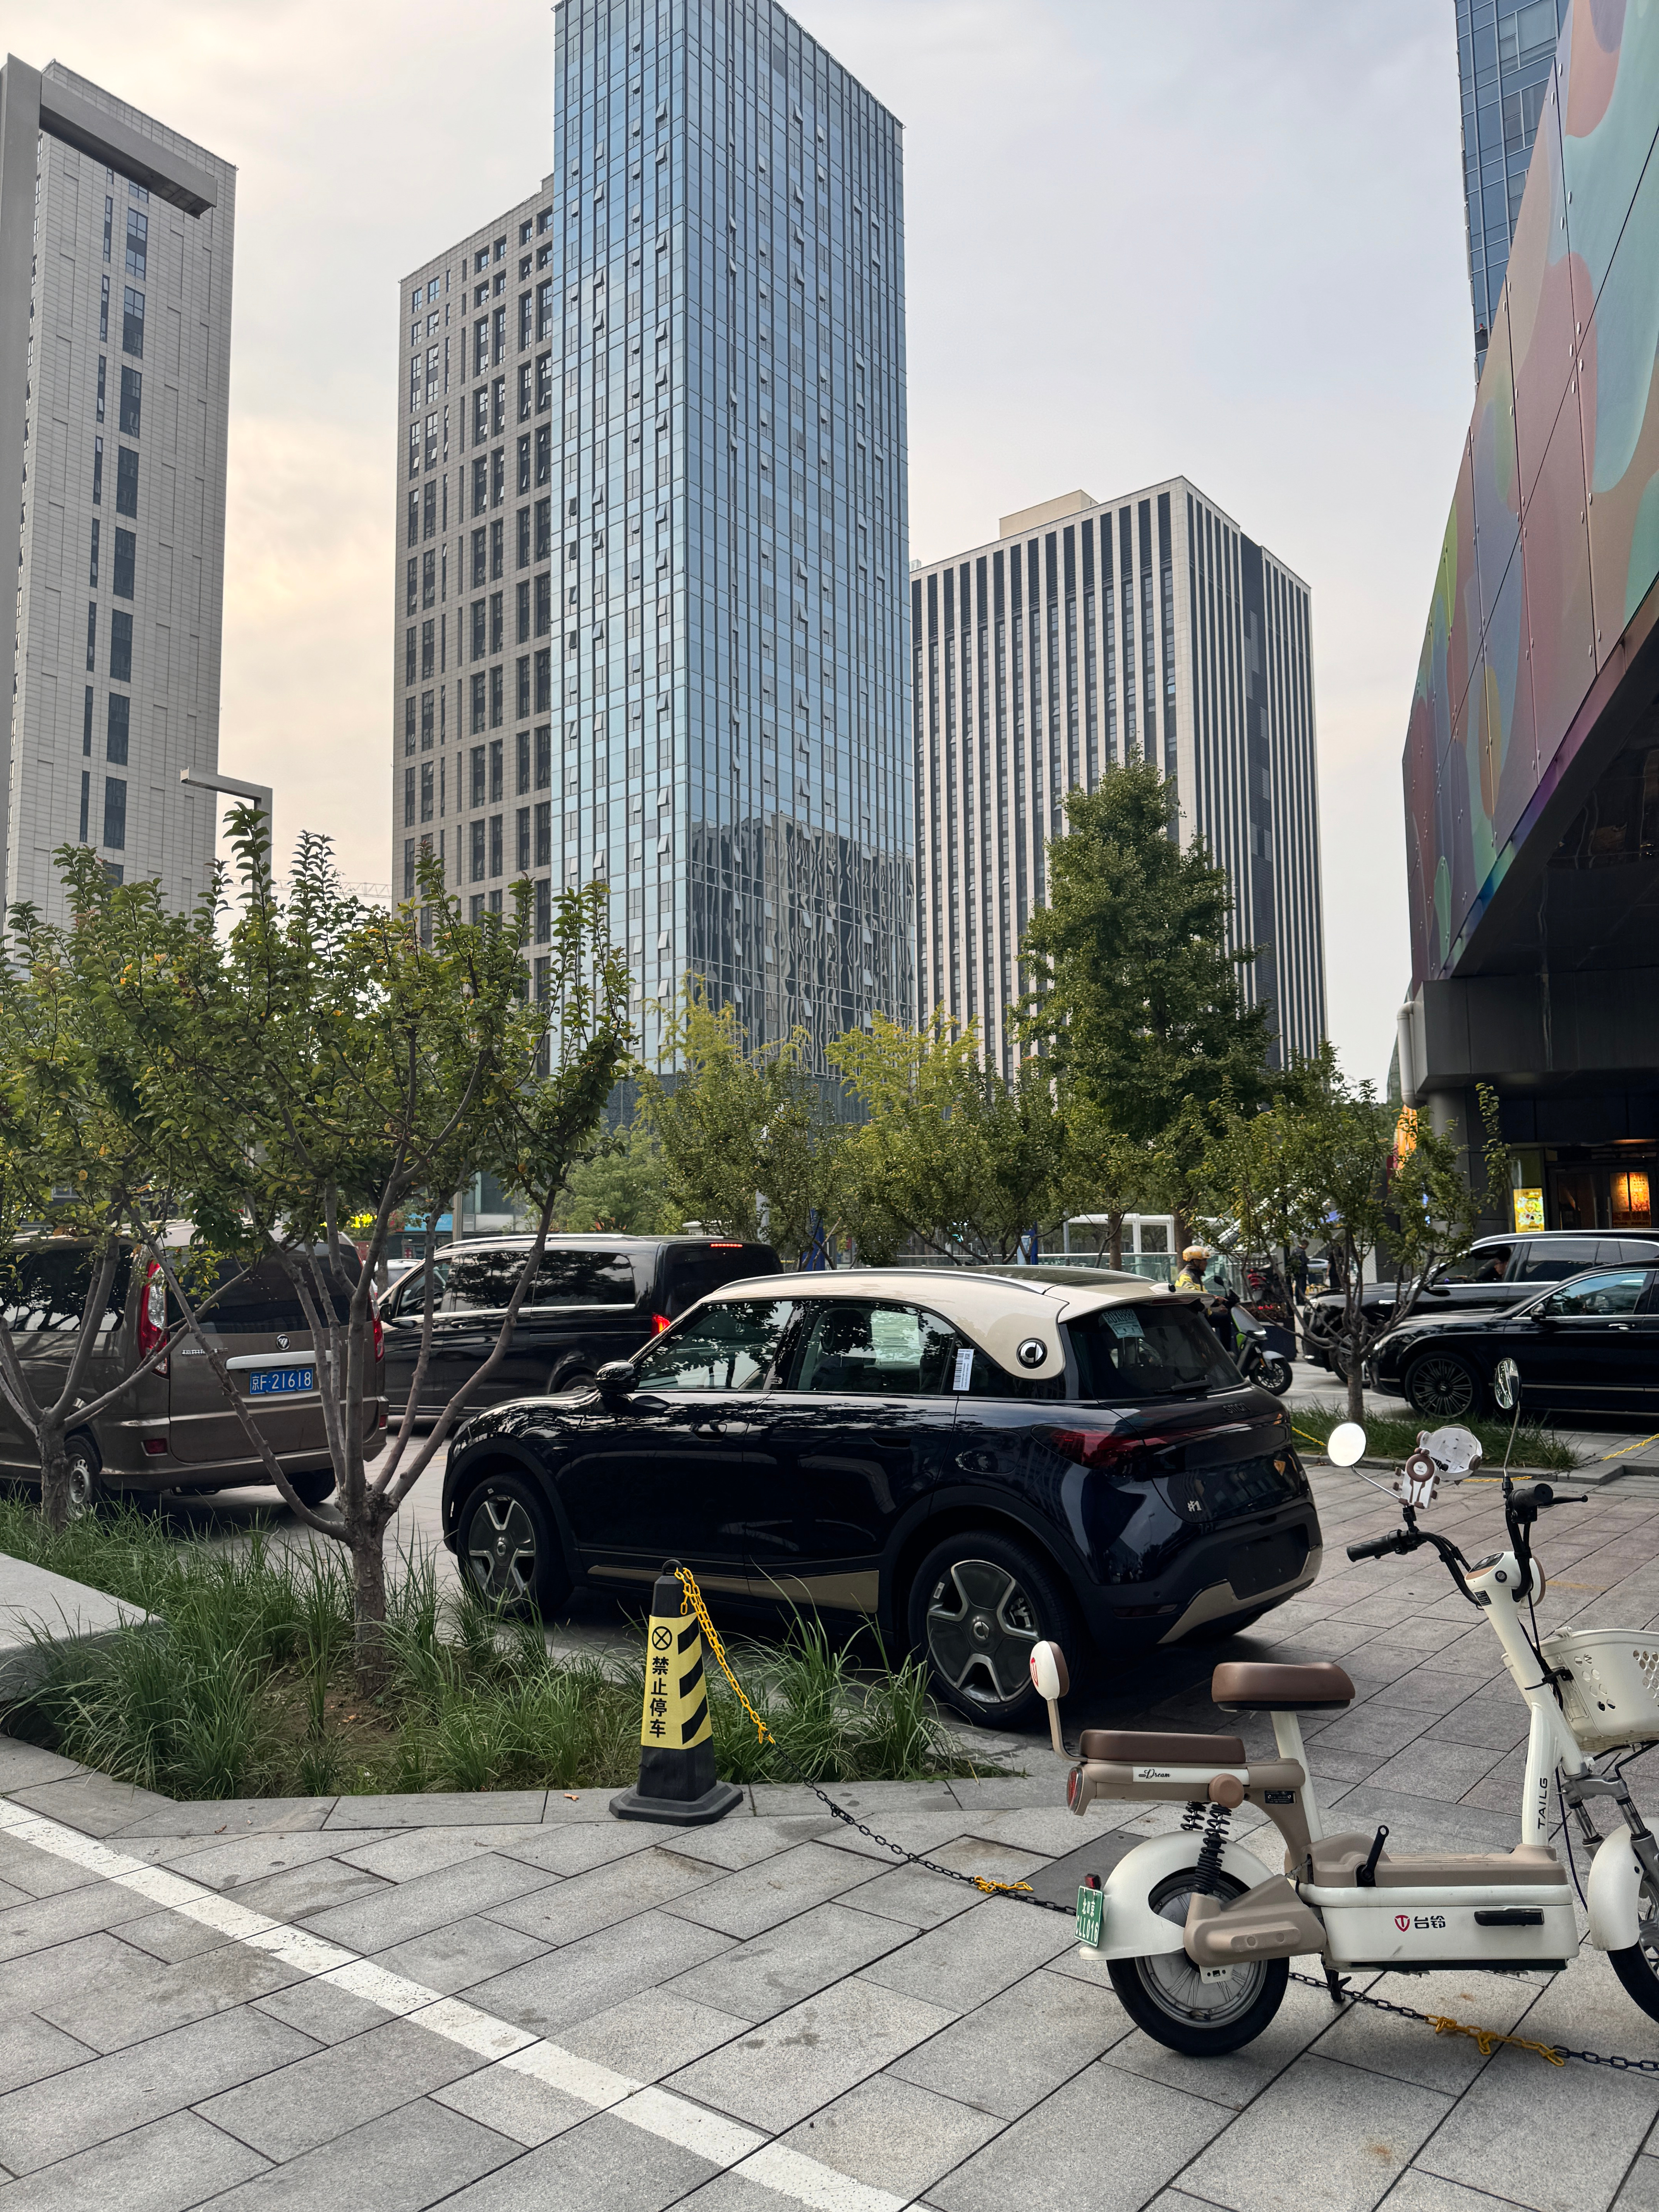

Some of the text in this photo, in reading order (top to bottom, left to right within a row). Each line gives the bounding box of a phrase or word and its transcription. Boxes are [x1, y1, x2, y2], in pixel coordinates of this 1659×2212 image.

[1187, 1500, 1202, 1512] #1
[649, 1656, 669, 1738] 禁止停车
[1144, 1769, 1171, 1779] Dream
[1538, 1778, 1547, 1829] TAILG
[1075, 1915, 1098, 1942] CLL016
[1414, 1915, 1446, 1929] 台铃
